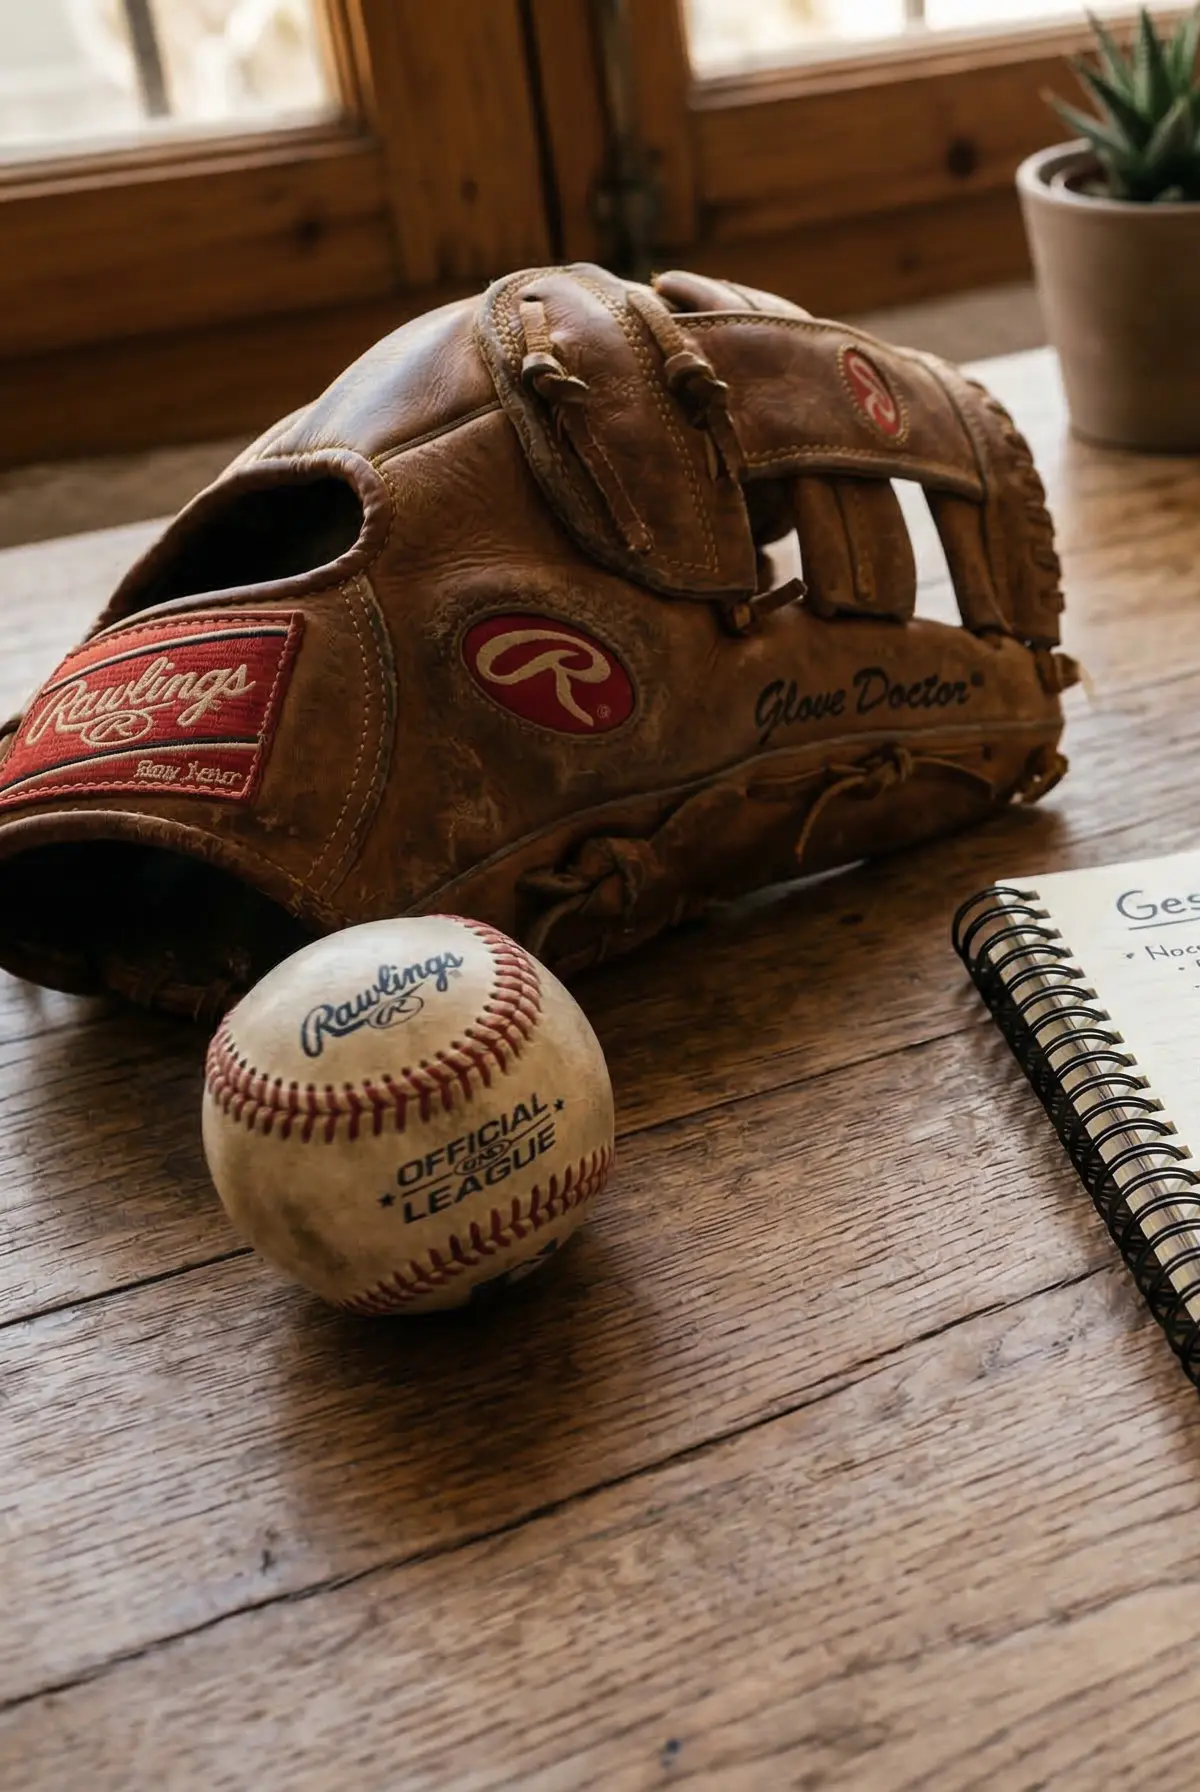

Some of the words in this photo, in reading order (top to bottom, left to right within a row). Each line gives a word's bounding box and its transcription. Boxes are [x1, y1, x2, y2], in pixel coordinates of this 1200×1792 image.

[24, 656, 256, 745] Rawlings
[755, 677, 846, 746] Glove
[853, 666, 971, 715] Doctor
[301, 952, 464, 1058] Rawlings
[397, 1092, 548, 1187] OFFICIAL
[403, 1122, 557, 1224] LEAGUE
